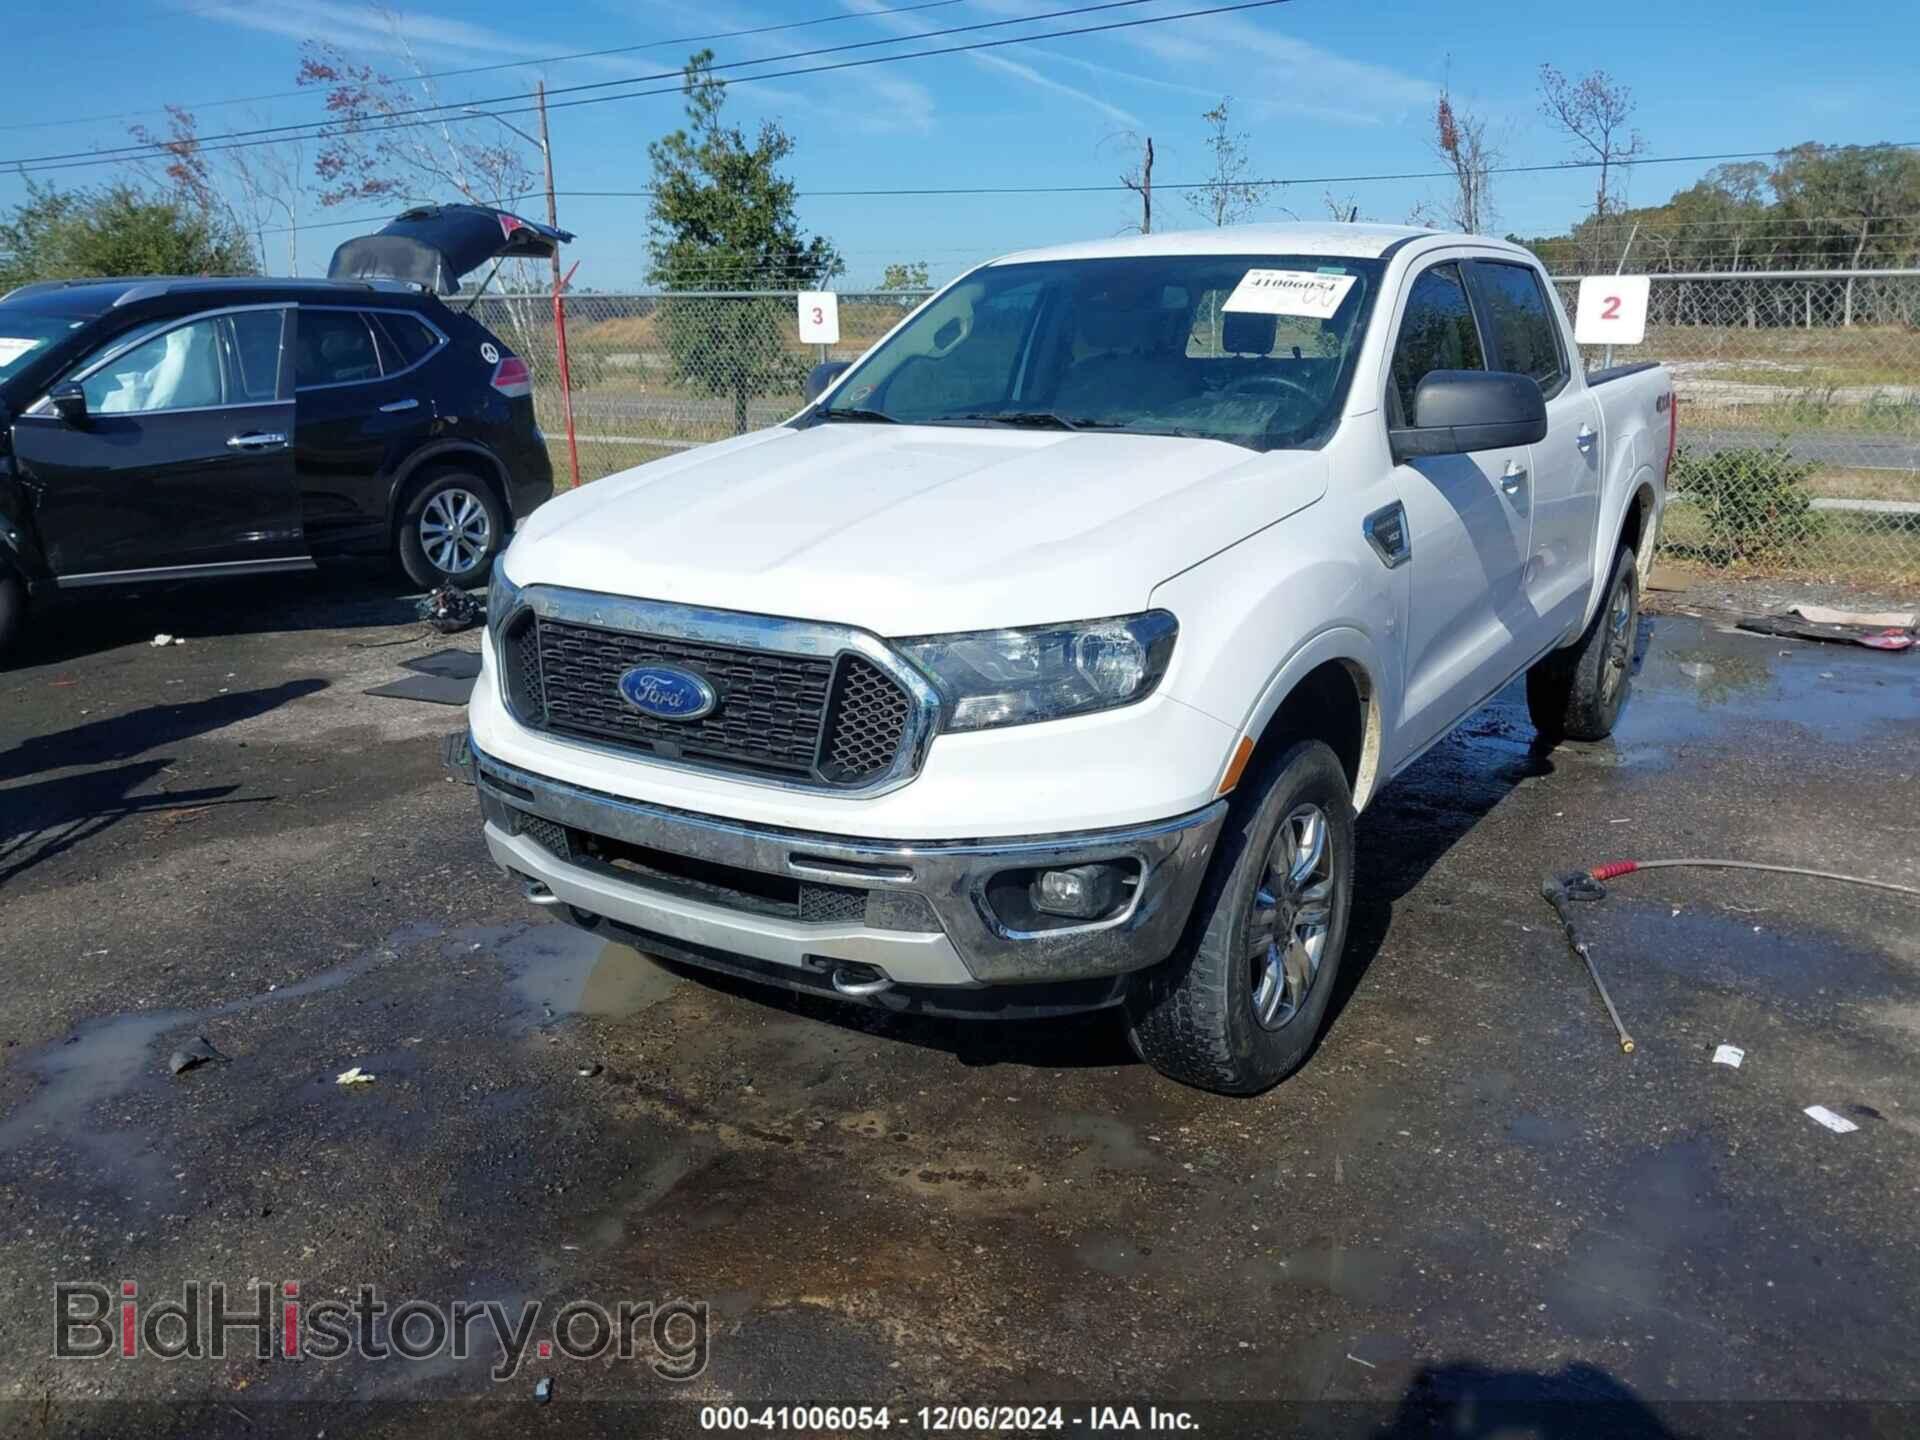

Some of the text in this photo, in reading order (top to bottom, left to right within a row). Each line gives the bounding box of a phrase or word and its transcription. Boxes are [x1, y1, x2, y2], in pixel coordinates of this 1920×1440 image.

[1251, 278, 1336, 292] 41006054
[812, 307, 823, 325] 3
[1601, 296, 1622, 319] 2
[634, 674, 685, 707] Ford
